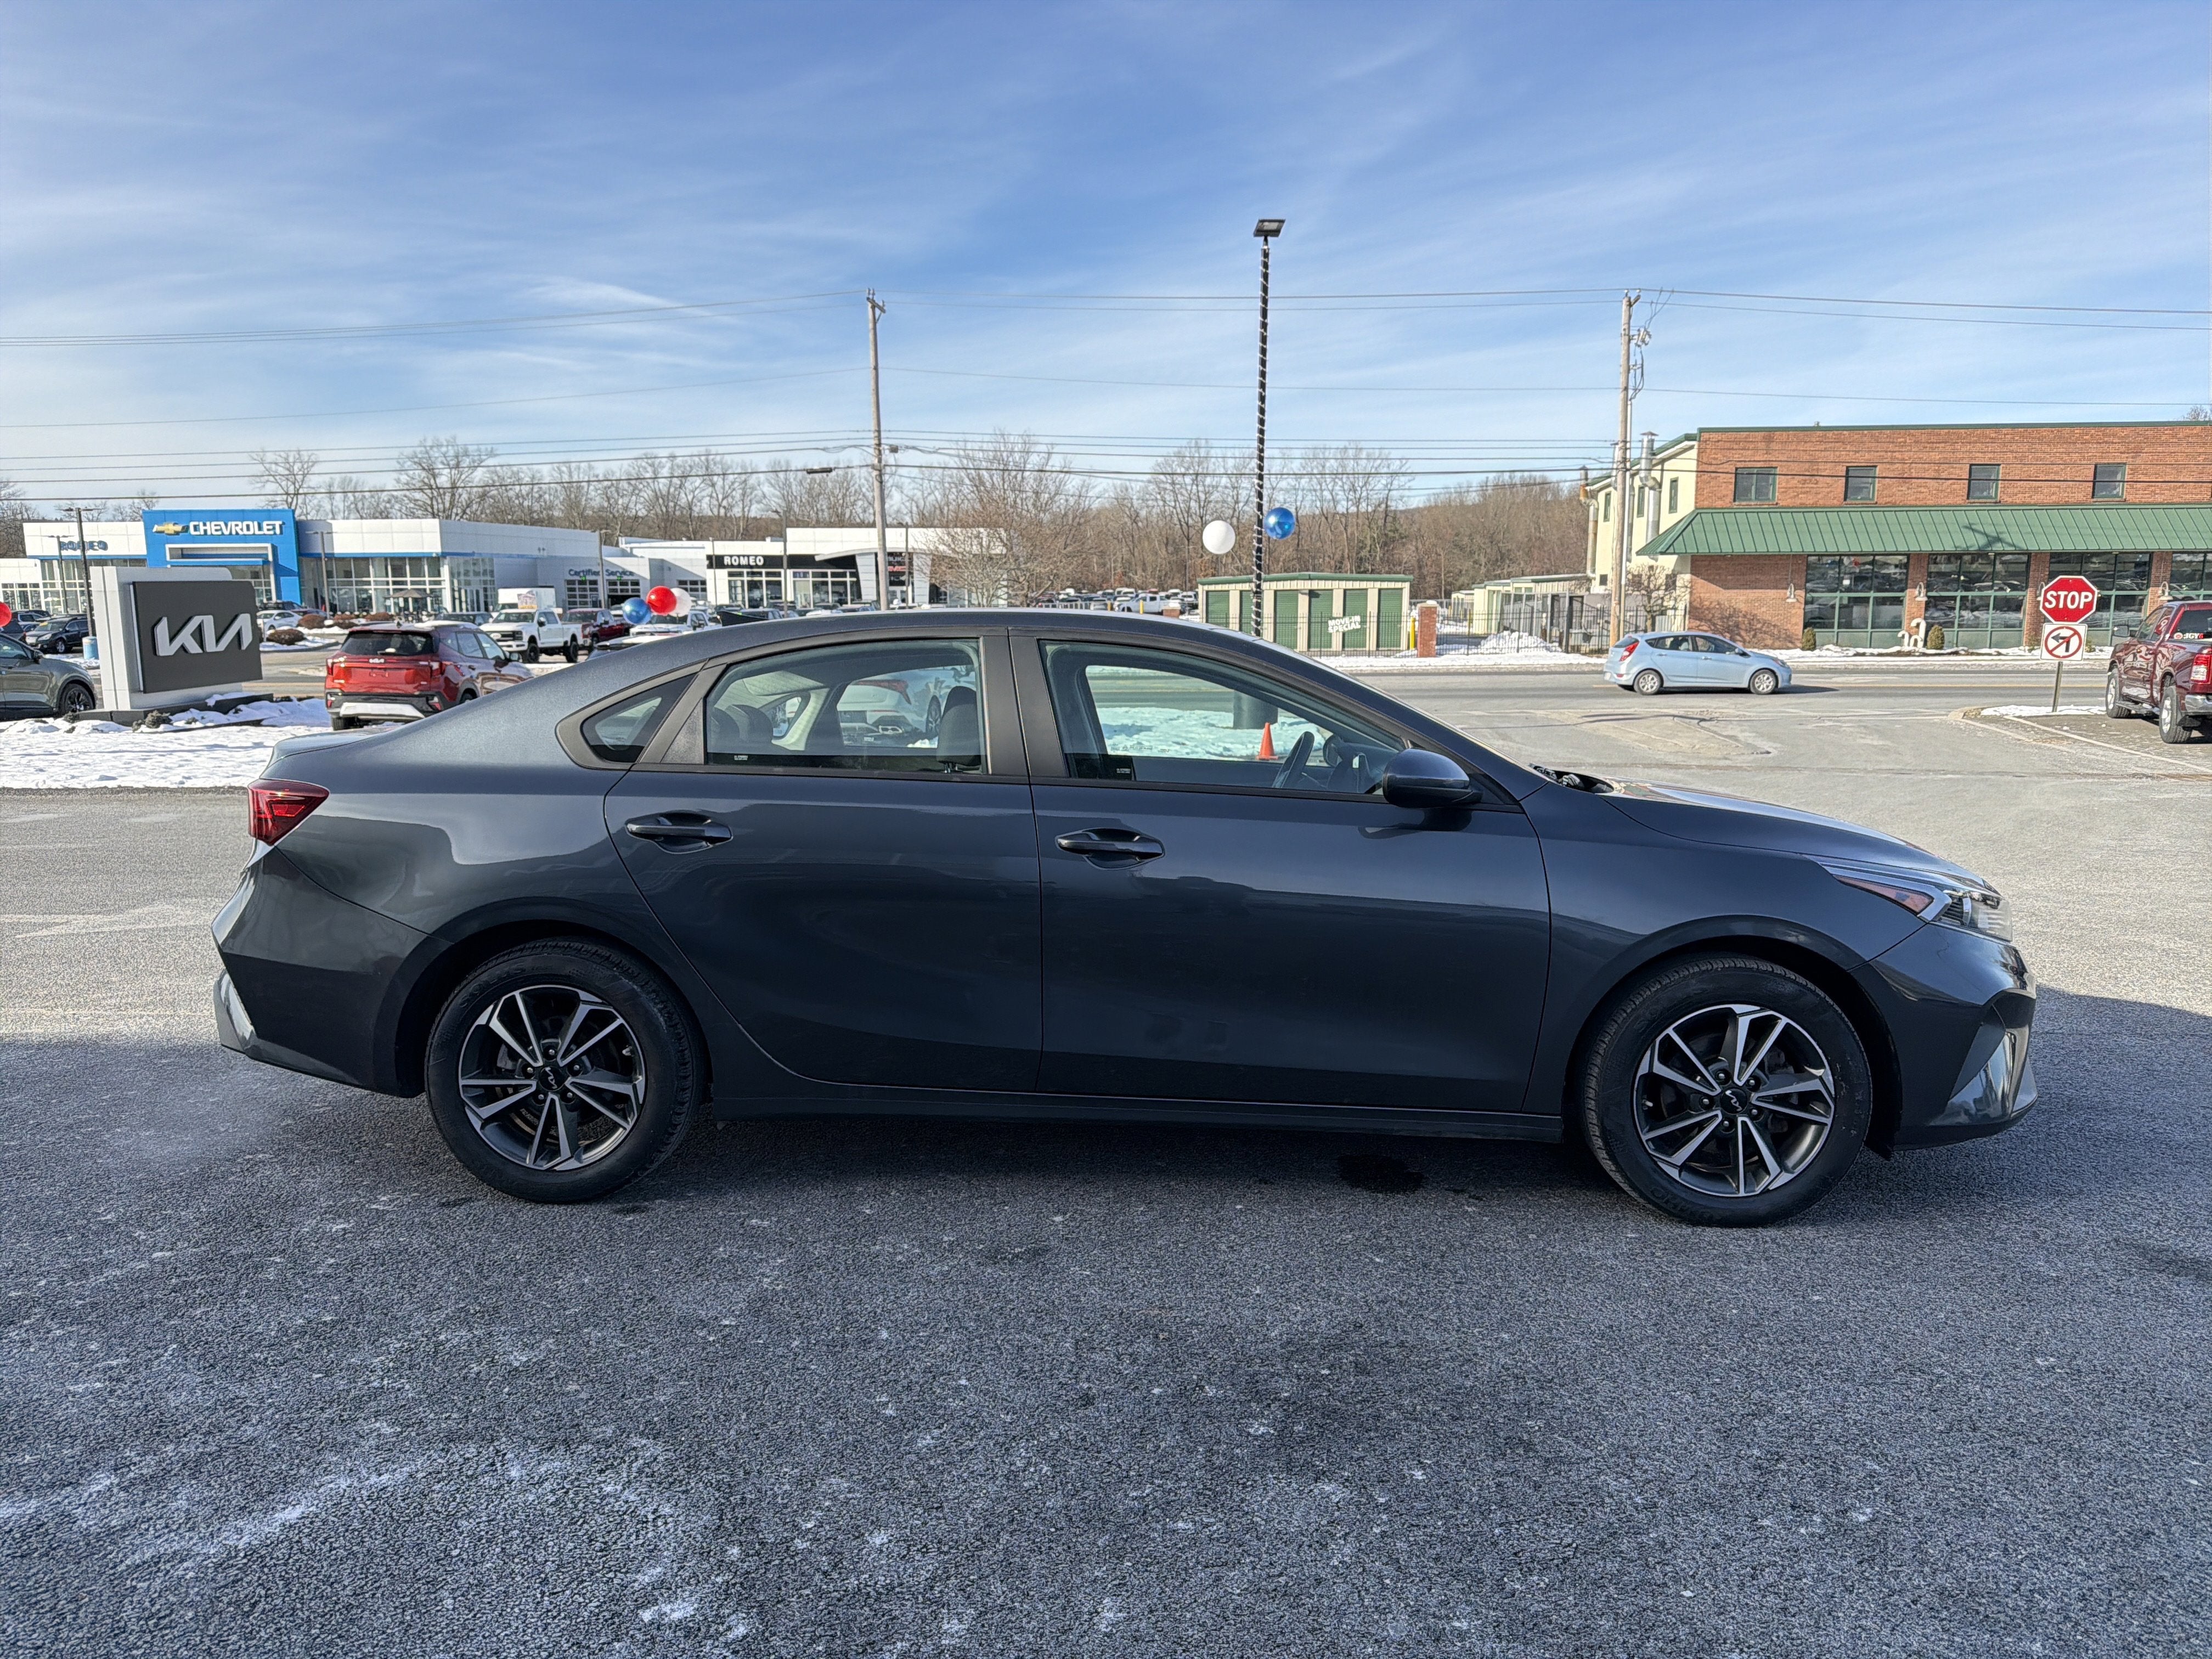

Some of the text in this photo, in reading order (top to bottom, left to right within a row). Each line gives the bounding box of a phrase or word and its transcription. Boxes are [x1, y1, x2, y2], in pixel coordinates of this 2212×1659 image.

[189, 521, 284, 535] CHEVROLET
[723, 556, 764, 566] ROMEO
[2044, 590, 2093, 609] STOP
[1327, 622, 1361, 633] SPECIAL
[1328, 615, 1361, 627] MOVE-IN
[153, 613, 253, 657] KIA
